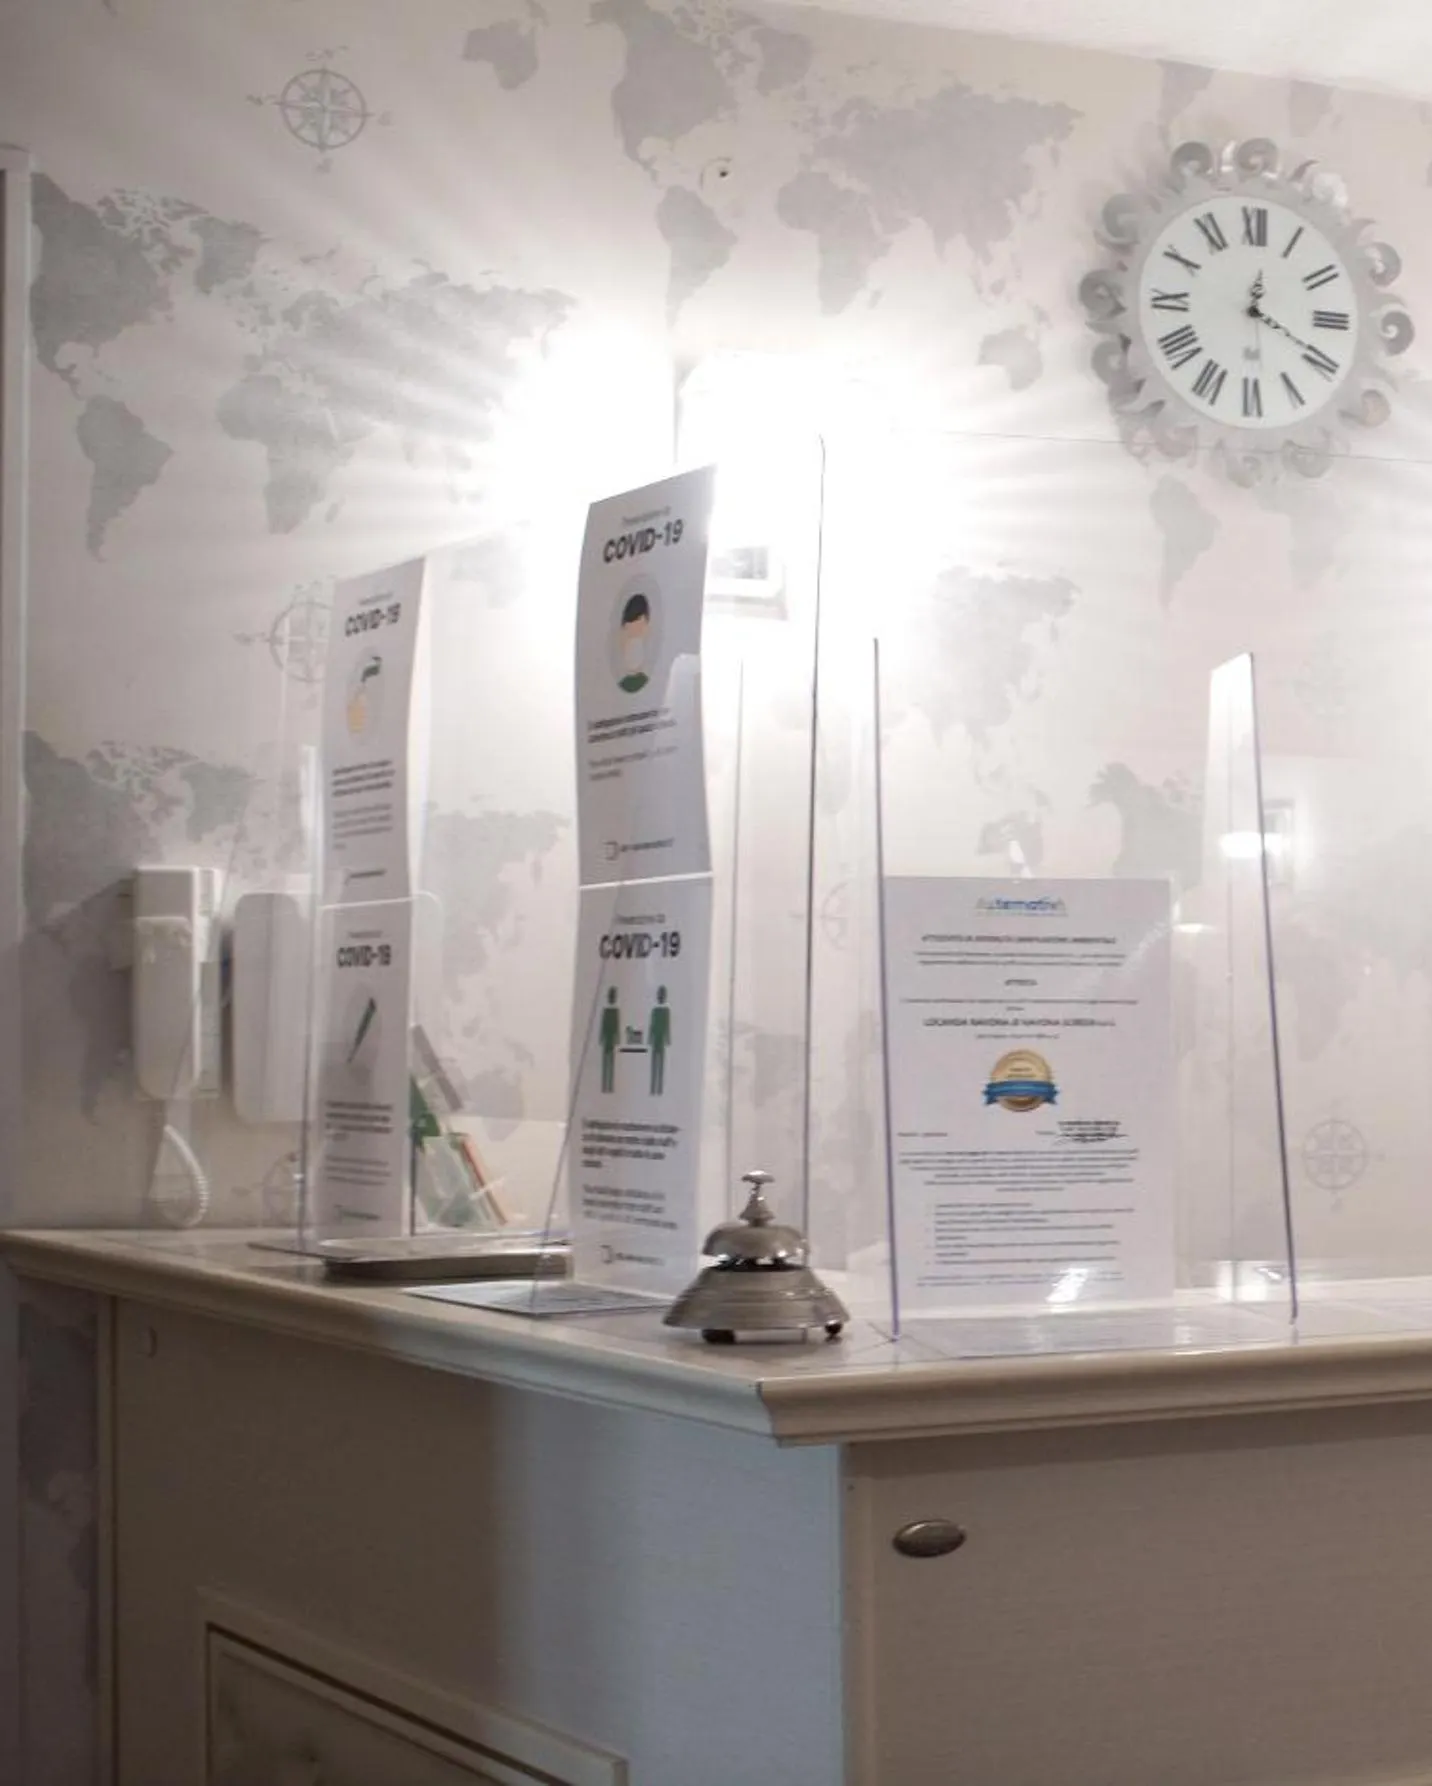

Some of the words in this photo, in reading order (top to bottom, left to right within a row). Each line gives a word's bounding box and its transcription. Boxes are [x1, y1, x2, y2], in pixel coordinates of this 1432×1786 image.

[1312, 310, 1350, 330] III
[603, 519, 685, 563] COVID-19
[344, 602, 402, 638] COVID-19
[337, 944, 393, 968] COVID-19
[599, 931, 681, 959] COVID-19
